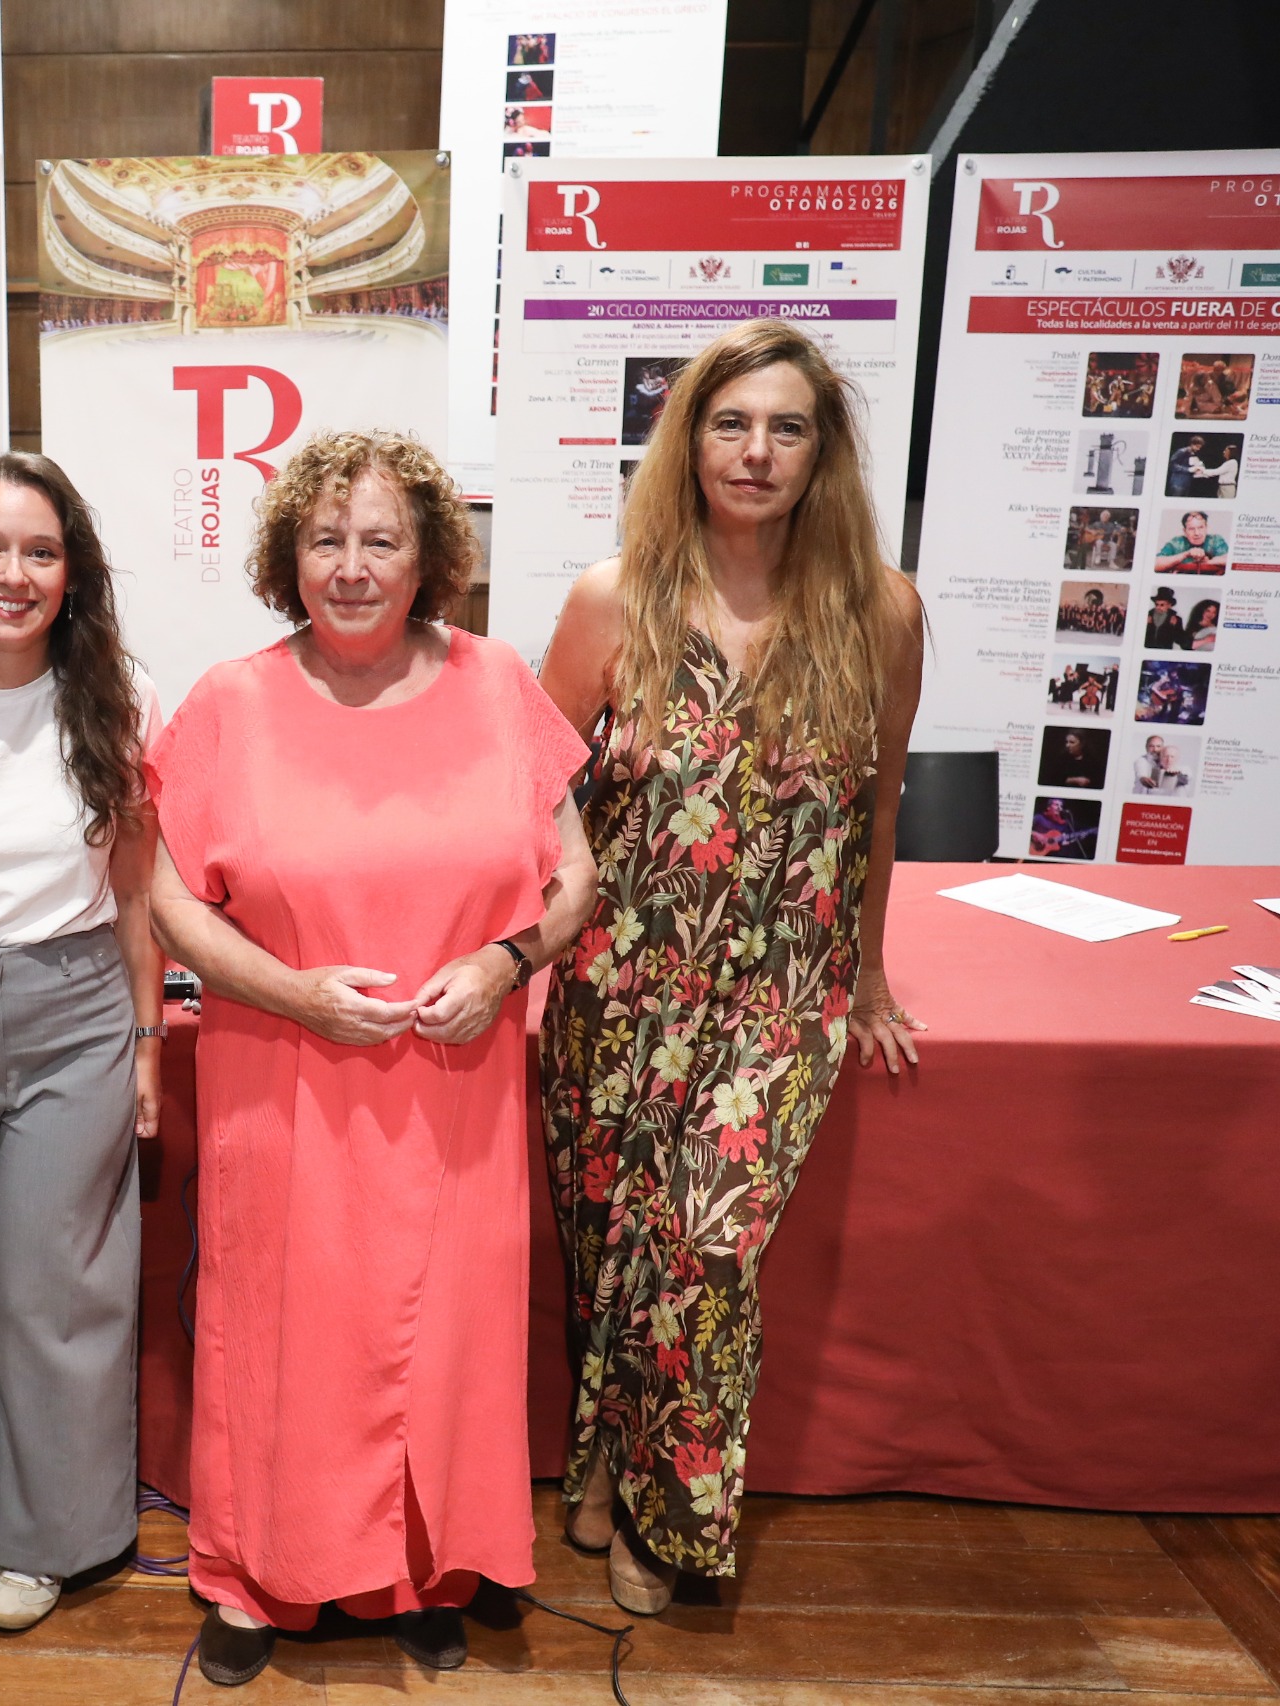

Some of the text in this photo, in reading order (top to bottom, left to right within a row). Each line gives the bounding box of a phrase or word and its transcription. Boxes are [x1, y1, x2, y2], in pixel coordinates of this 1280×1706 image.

[233, 135, 269, 144] TEATRO
[222, 146, 269, 154] DE ROJAS
[730, 182, 898, 198] PROGRAMACIÓN
[769, 195, 898, 211] OTOÑO2026
[545, 227, 572, 235] ROJAS
[996, 226, 1028, 234] ROJAS
[588, 303, 831, 318] 20 CICLO INTERNACIONAL DE DANZA
[1027, 298, 1166, 317] ESPECTÁCULOS
[1170, 301, 1235, 317] FUERA
[1241, 301, 1267, 317] DE
[1037, 319, 1064, 329] Todas
[1065, 319, 1079, 329] las
[1080, 319, 1133, 329] localidades
[1142, 320, 1151, 329] la
[1152, 321, 1180, 330] venta
[1188, 320, 1215, 332] partir
[1216, 320, 1232, 330] del
[1233, 321, 1244, 330] 11
[1246, 320, 1259, 330] de
[1051, 351, 1081, 360] Trash!
[577, 357, 619, 367] Carmen
[831, 358, 896, 369] de los cisnes
[1014, 427, 1071, 438] Gala entrega
[1022, 436, 1033, 444] de
[1249, 434, 1267, 442] Dos
[1002, 443, 1069, 453] Teatro de Rojas
[1003, 451, 1068, 461] XXXIV Edición
[572, 459, 614, 470] On Time
[1008, 503, 1062, 512] Kiko Veneno
[173, 468, 193, 561] TEATRO
[1238, 513, 1277, 523] Gigante,
[201, 467, 220, 583] DE ROJAS
[949, 575, 988, 584] Concierto
[1023, 587, 1052, 596] Teatro,
[1226, 589, 1272, 599] Antología
[954, 592, 974, 600] años
[975, 592, 986, 601] de
[987, 593, 1013, 602] Poesía
[1022, 594, 1051, 603] Música
[1016, 604, 1050, 612] CULTURAS
[977, 648, 1045, 661] Bohemian Spirit
[1217, 663, 1275, 673] Kike Calzada
[1006, 721, 1035, 731] Poncia
[1207, 737, 1241, 746] Esencia
[1141, 812, 1161, 820] TODA
[1126, 820, 1185, 831] PROGRAMACIÓN
[1130, 829, 1178, 839] ACTUALIZADA
[1147, 838, 1158, 846] EN
